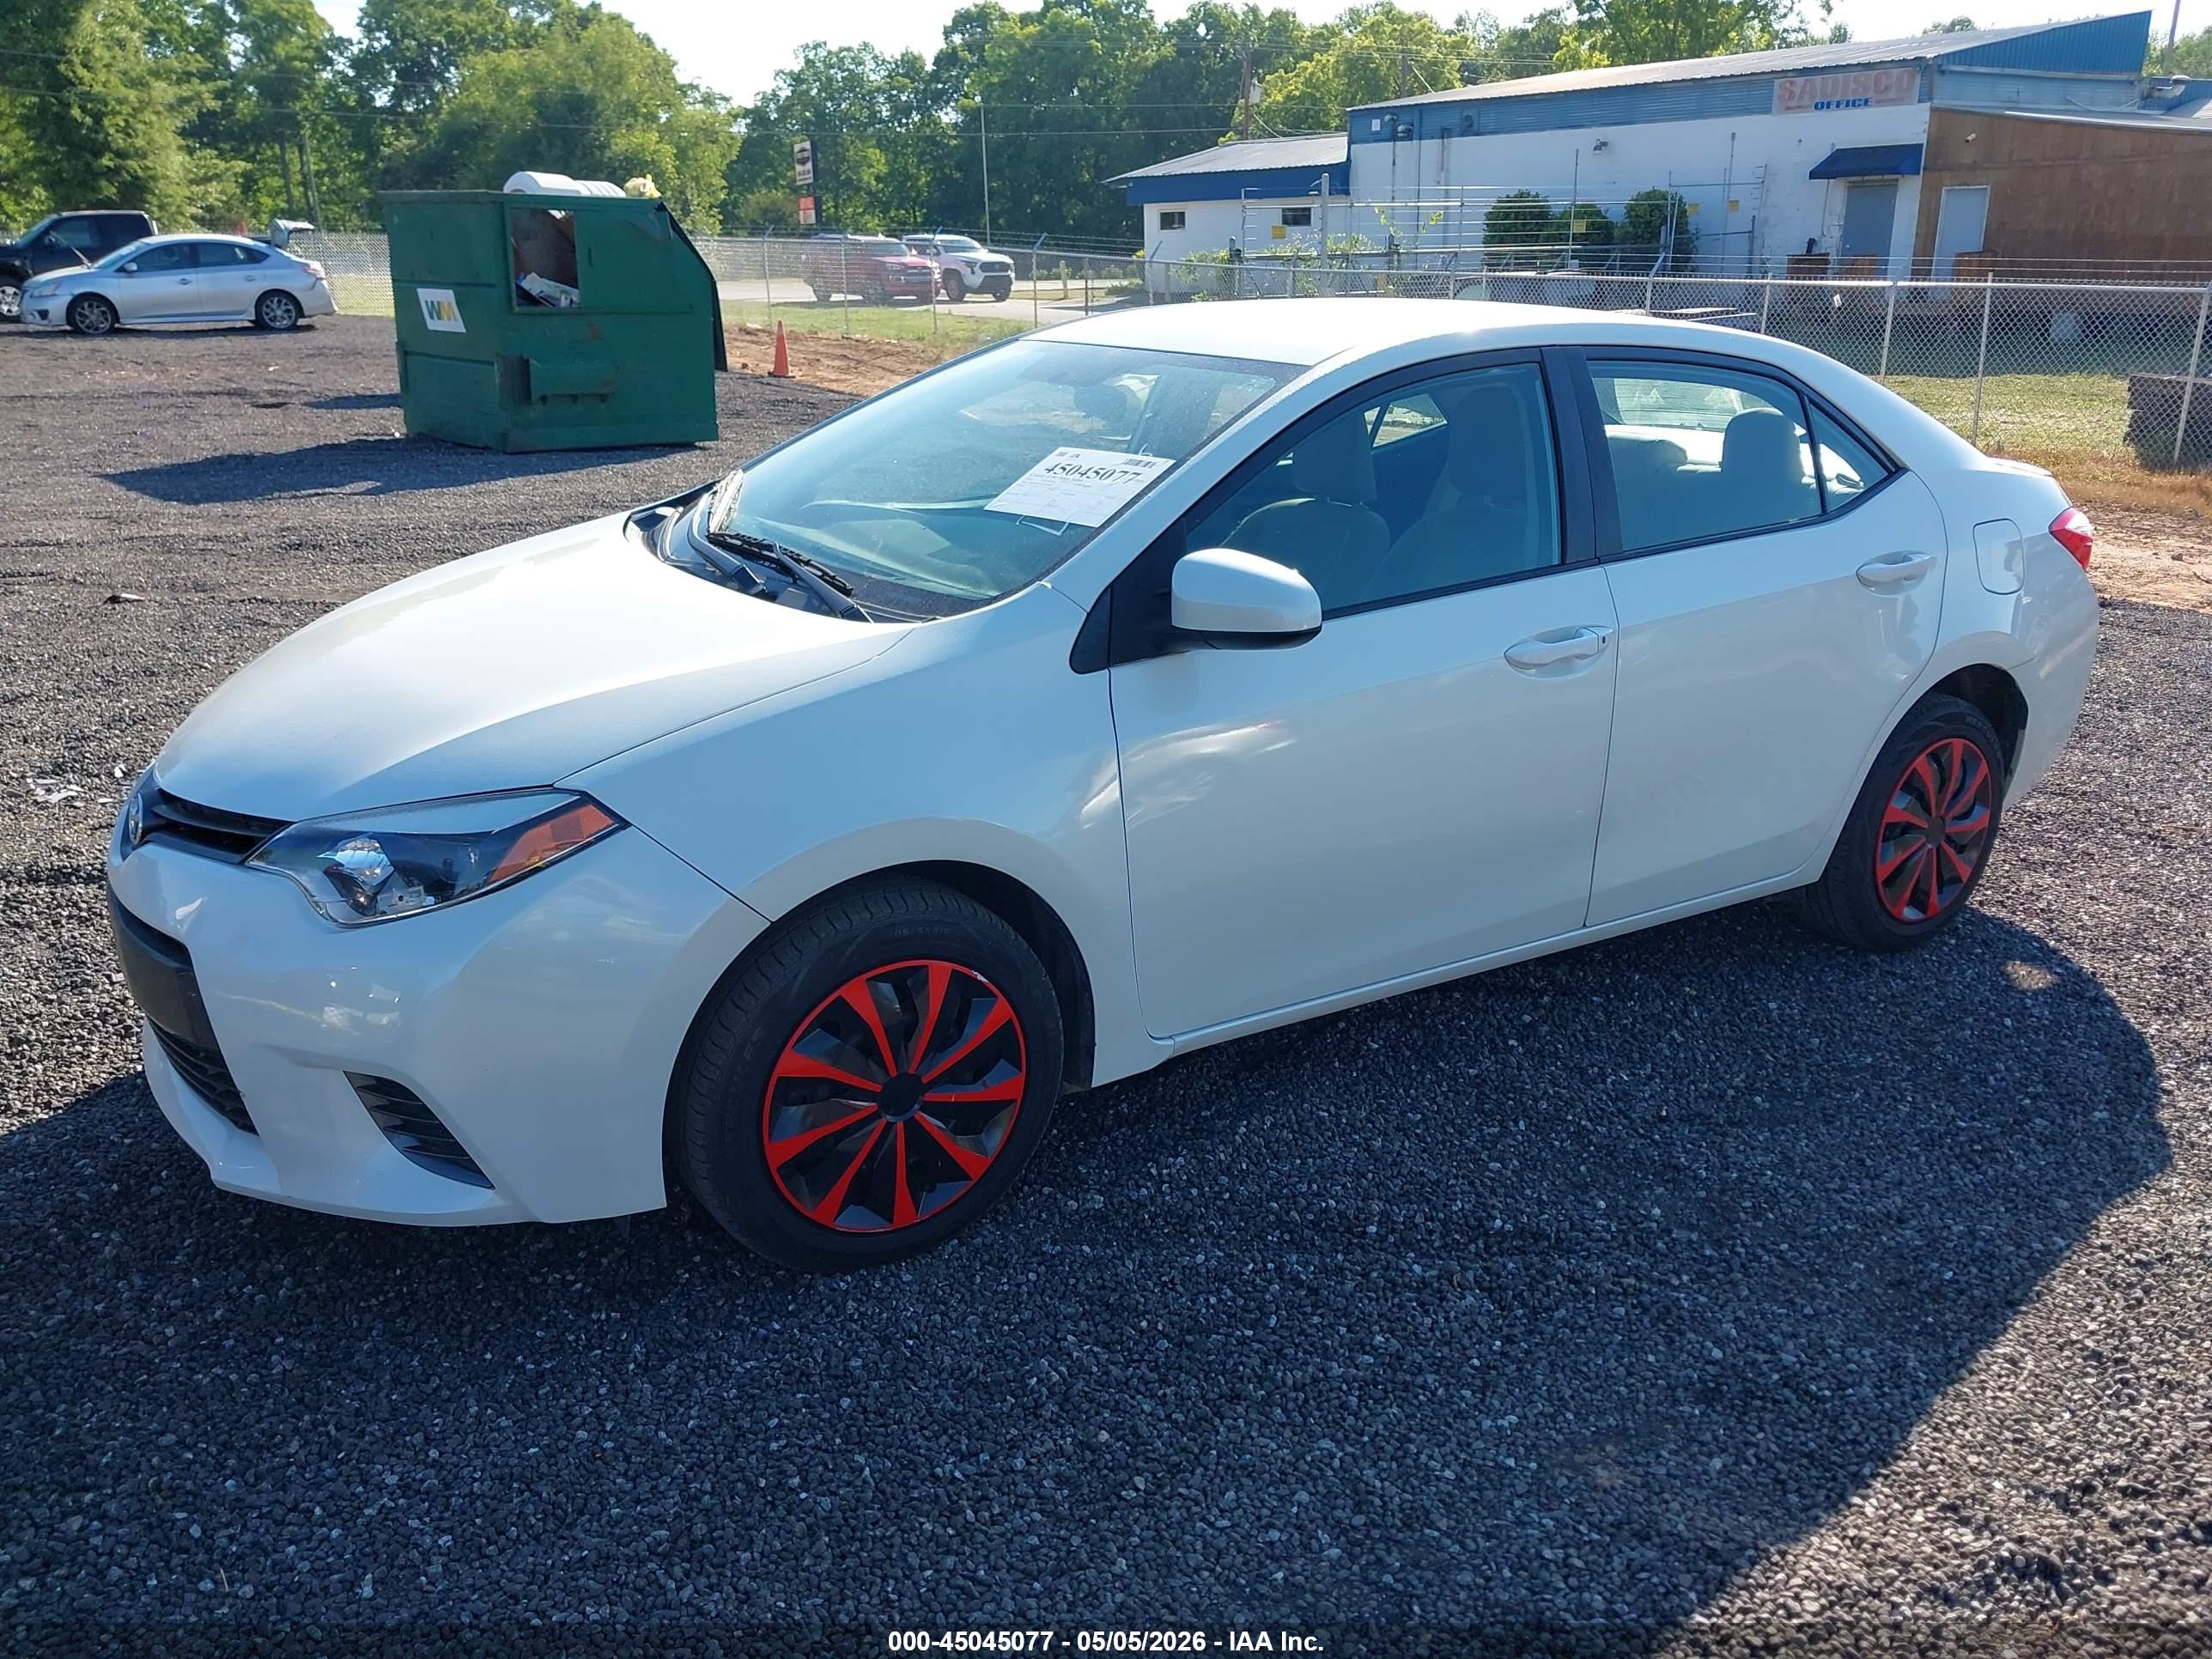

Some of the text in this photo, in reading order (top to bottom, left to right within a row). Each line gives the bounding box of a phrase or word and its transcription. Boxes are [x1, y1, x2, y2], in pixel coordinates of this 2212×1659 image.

[1778, 70, 1917, 102] SADISCO
[1814, 97, 1874, 111] OFFICE
[424, 300, 459, 322] WM
[1044, 462, 1143, 484] 45045077
